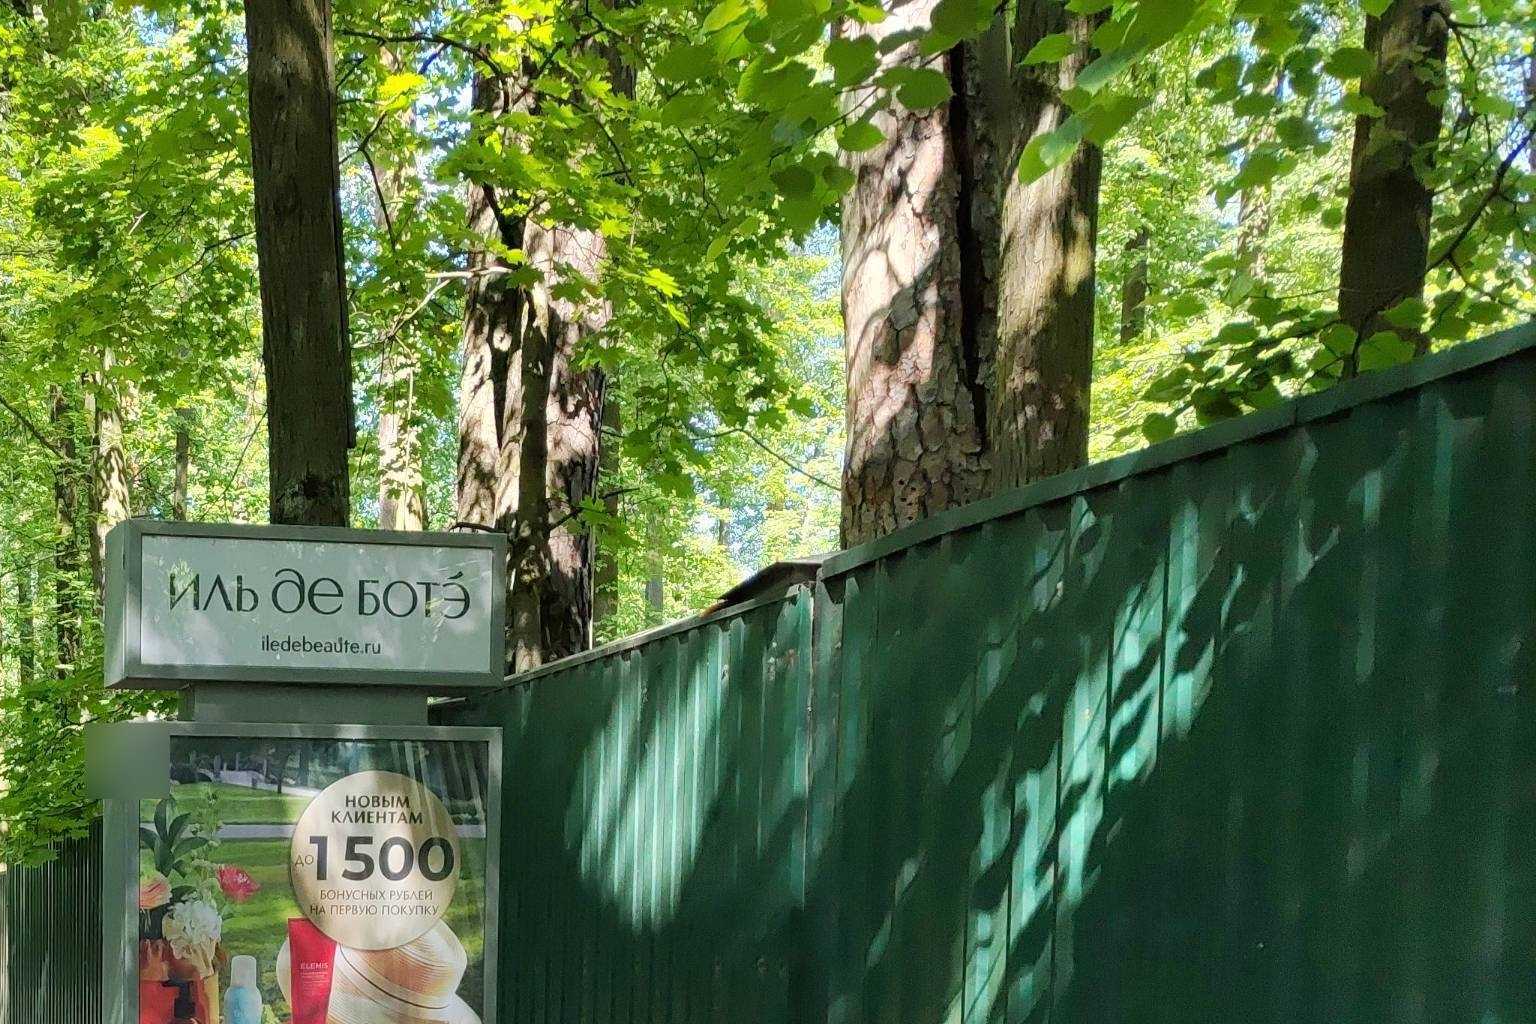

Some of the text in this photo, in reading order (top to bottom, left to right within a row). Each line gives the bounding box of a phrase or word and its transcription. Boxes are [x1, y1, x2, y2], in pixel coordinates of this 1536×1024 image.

[169, 572, 259, 612] ИЛЬ
[261, 634, 381, 655] iledebeaute.ru
[345, 795, 410, 808] НОВЫМ
[331, 810, 424, 824] КЛИЕНТАМ
[309, 835, 455, 882] 1500
[320, 888, 433, 901] БОНУСНЫХ РУБЛЕЙ
[310, 904, 440, 916] НА ПЕРВУЮ ПОКУПКУ
